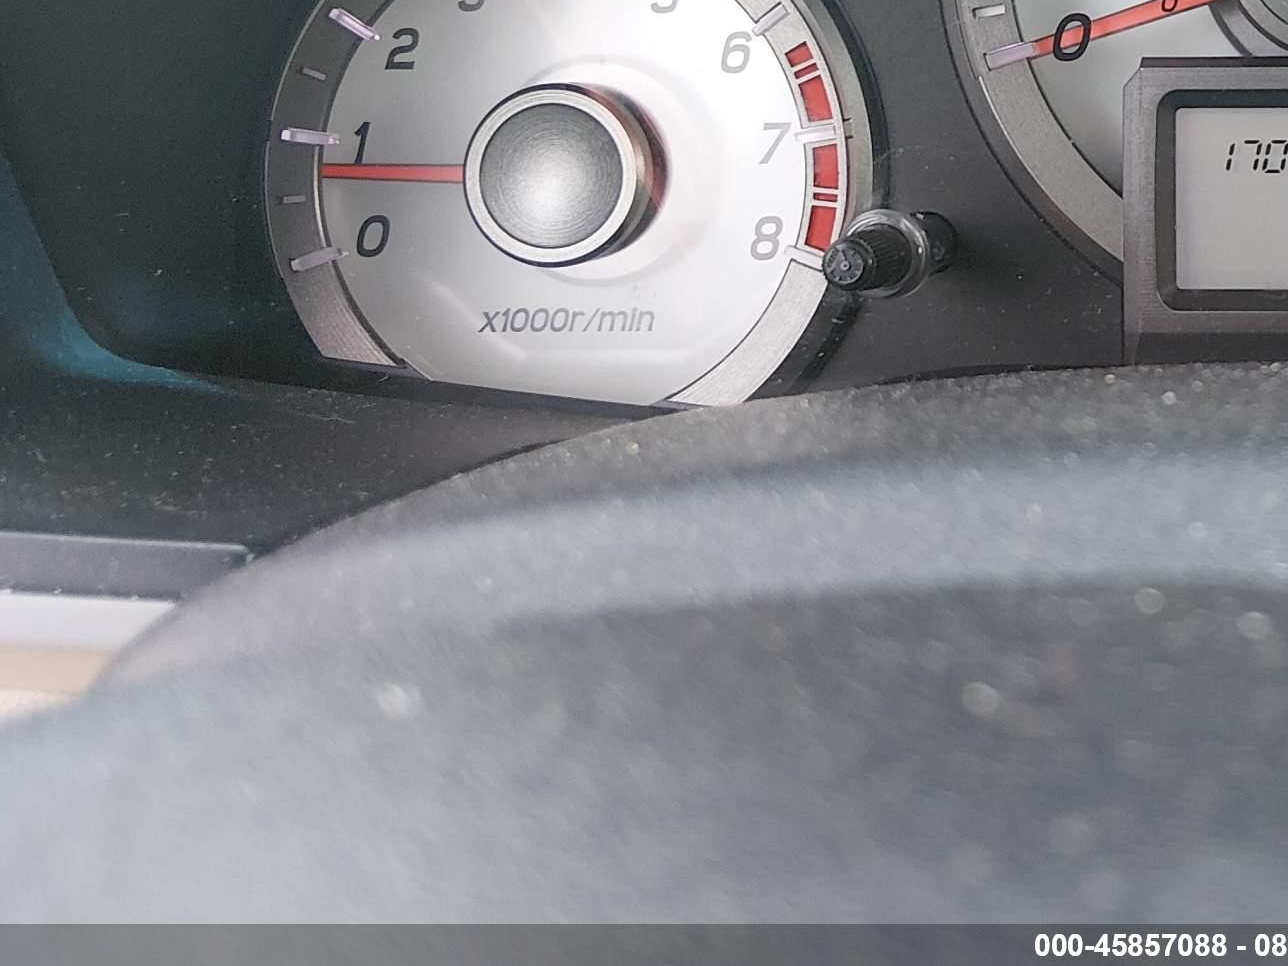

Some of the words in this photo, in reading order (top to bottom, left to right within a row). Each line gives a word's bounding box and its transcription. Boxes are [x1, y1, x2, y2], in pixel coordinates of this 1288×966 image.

[384, 27, 420, 70] 2
[720, 31, 754, 73] 6
[1053, 13, 1092, 61] 0
[353, 121, 371, 164] 1
[759, 122, 791, 165] 7
[355, 214, 390, 258] 0
[750, 215, 784, 259] 8
